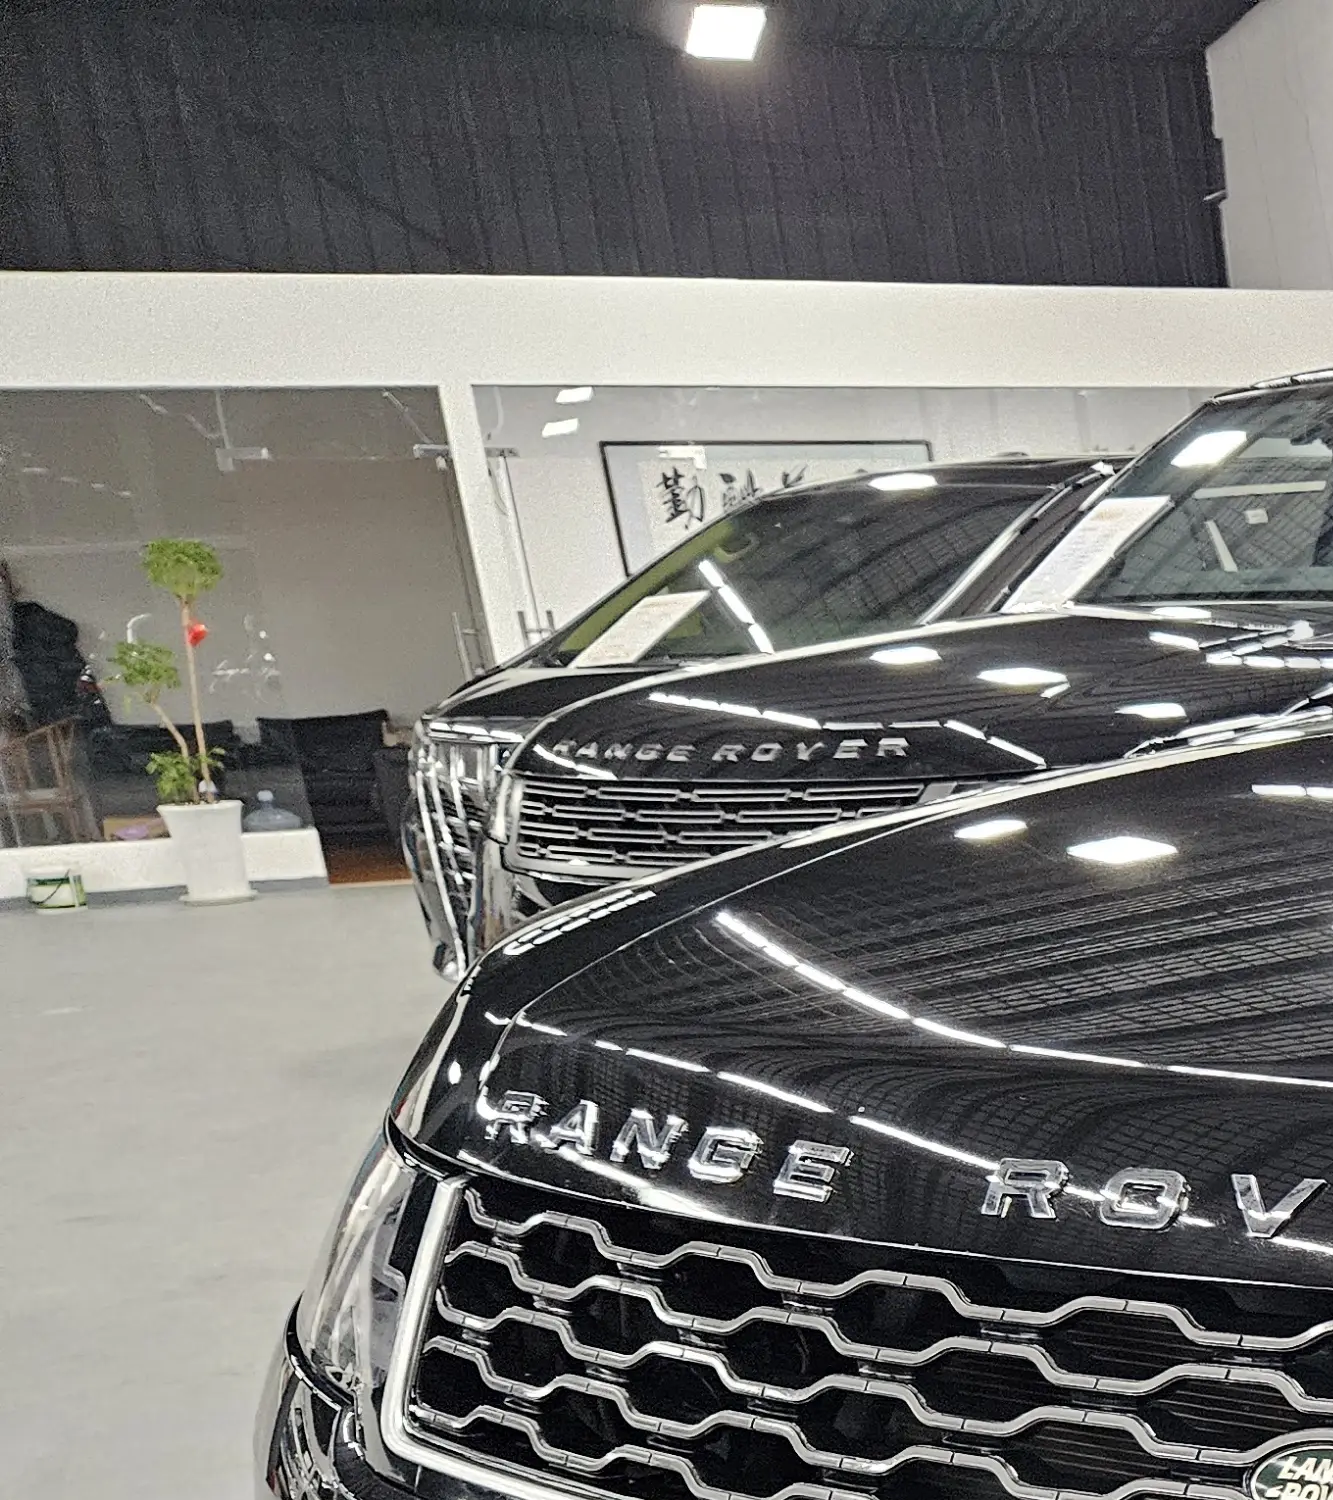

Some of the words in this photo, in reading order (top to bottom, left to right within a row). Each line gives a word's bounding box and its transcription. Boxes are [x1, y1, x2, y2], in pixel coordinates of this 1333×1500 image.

[552, 739, 695, 762] RANGE
[711, 737, 910, 762] ROVER
[485, 1090, 855, 1203] RANGE
